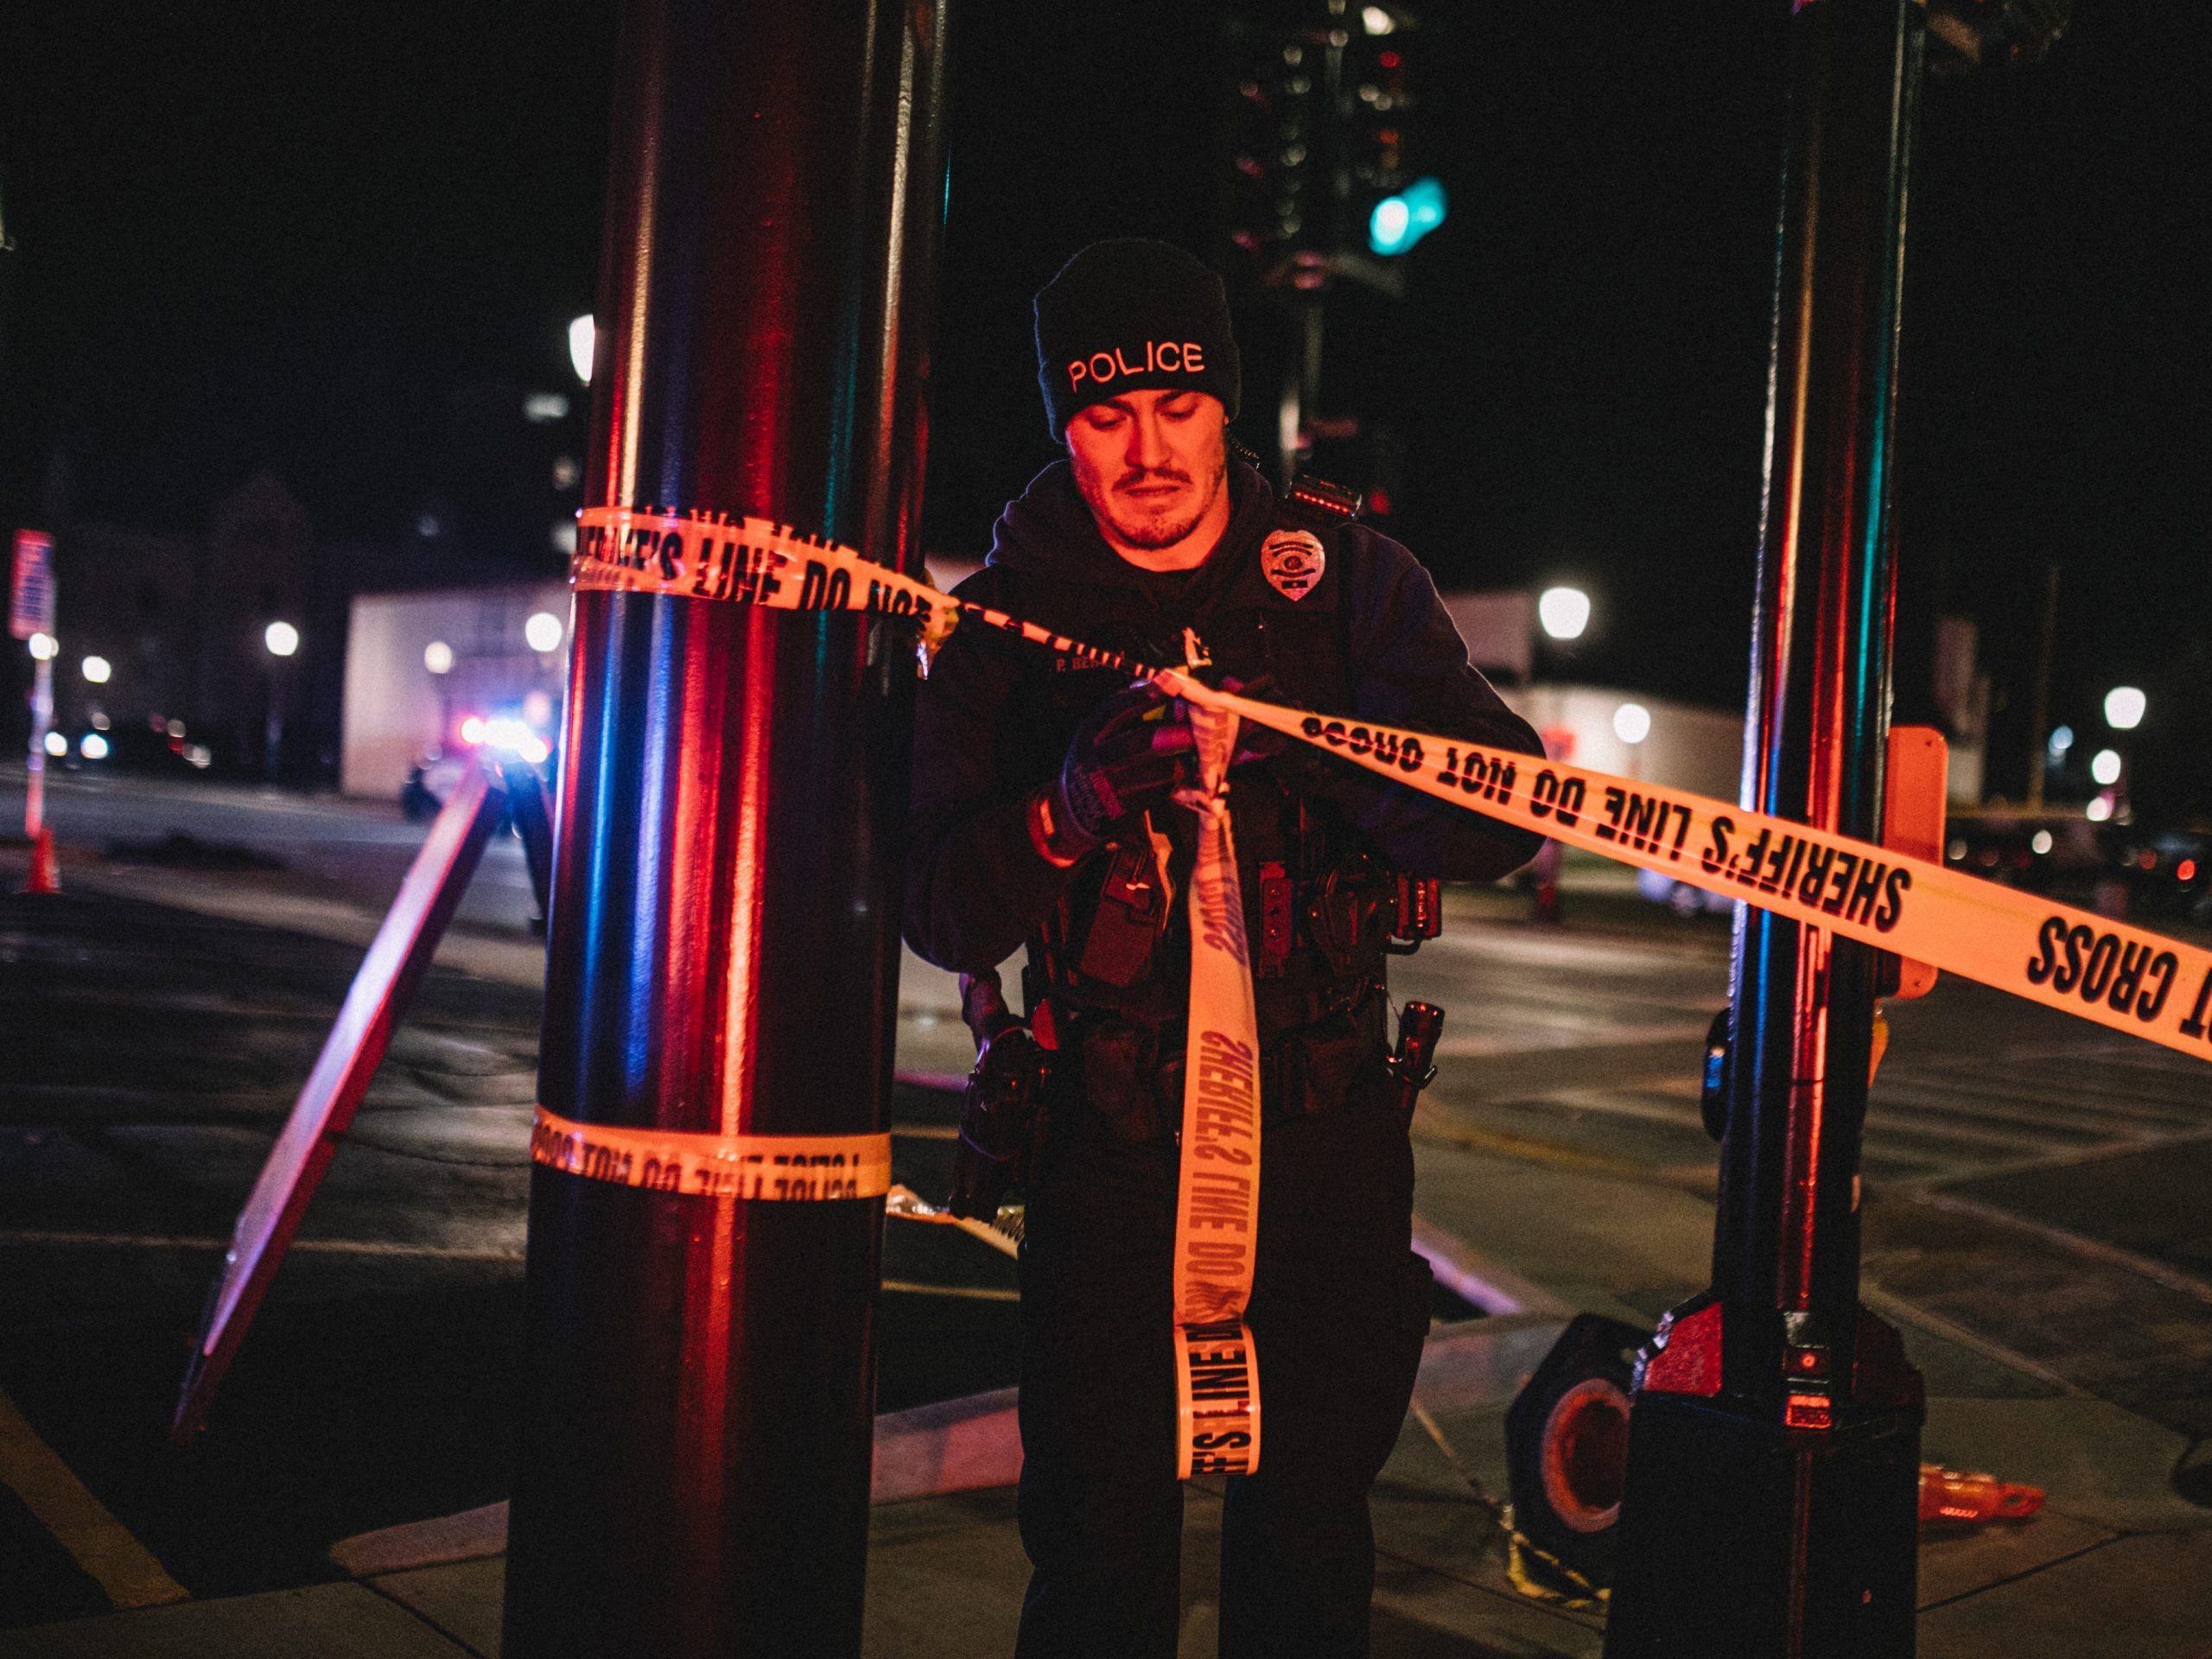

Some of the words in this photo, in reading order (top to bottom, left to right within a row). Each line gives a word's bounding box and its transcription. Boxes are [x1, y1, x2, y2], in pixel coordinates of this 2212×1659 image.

[1068, 340, 1205, 393] POLICE
[798, 559, 851, 610] DO
[1436, 747, 1516, 805] NOT
[1529, 769, 1586, 827] DO
[1596, 785, 1692, 861] LINE
[1700, 816, 1913, 934] SHERIFF'S
[2027, 916, 2179, 1023] CROSS
[1189, 1348, 1251, 1419] LINE
